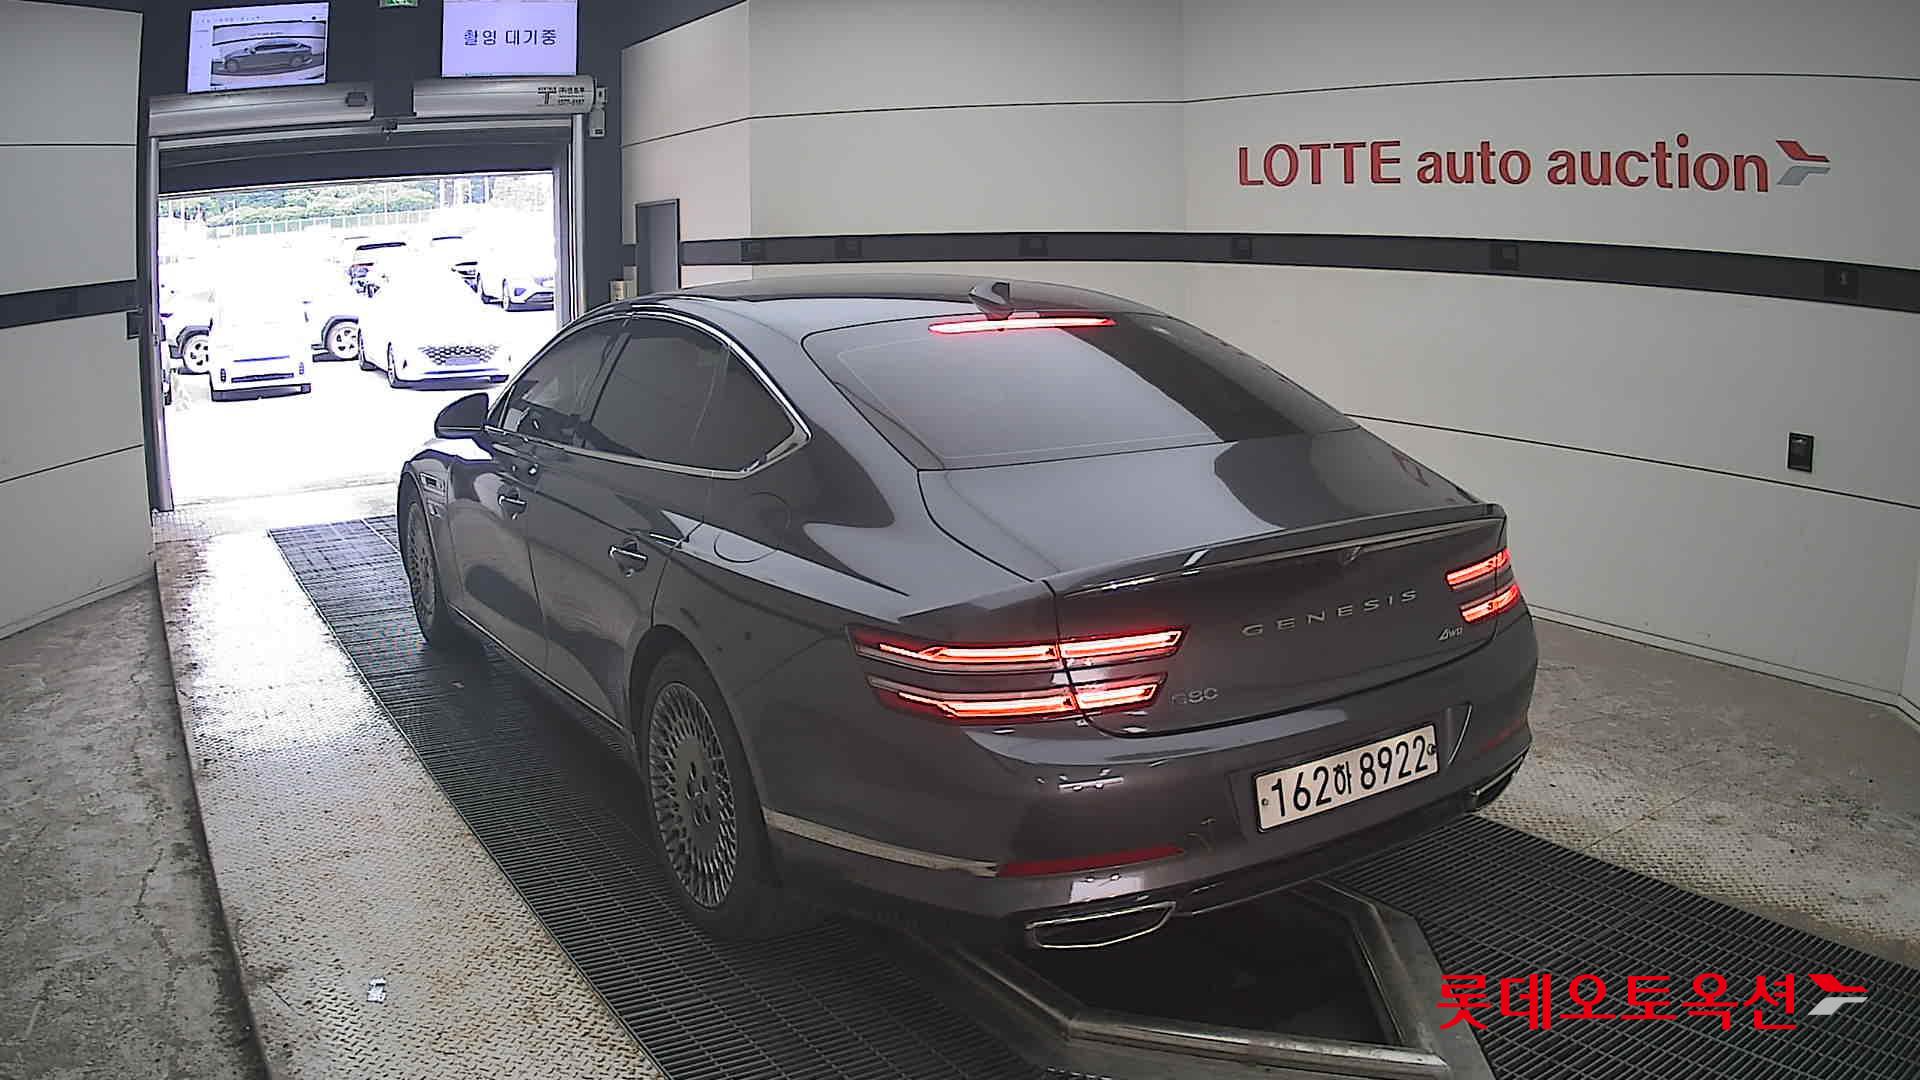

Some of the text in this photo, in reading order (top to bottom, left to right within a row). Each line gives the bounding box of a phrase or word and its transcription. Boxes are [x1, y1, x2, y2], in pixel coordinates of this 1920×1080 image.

[505, 29, 557, 46] 대기중
[1238, 133, 1769, 193] LOTTE auto auction
[1241, 589, 1417, 637] GENESIS
[1271, 735, 1429, 818] 162하 8922
